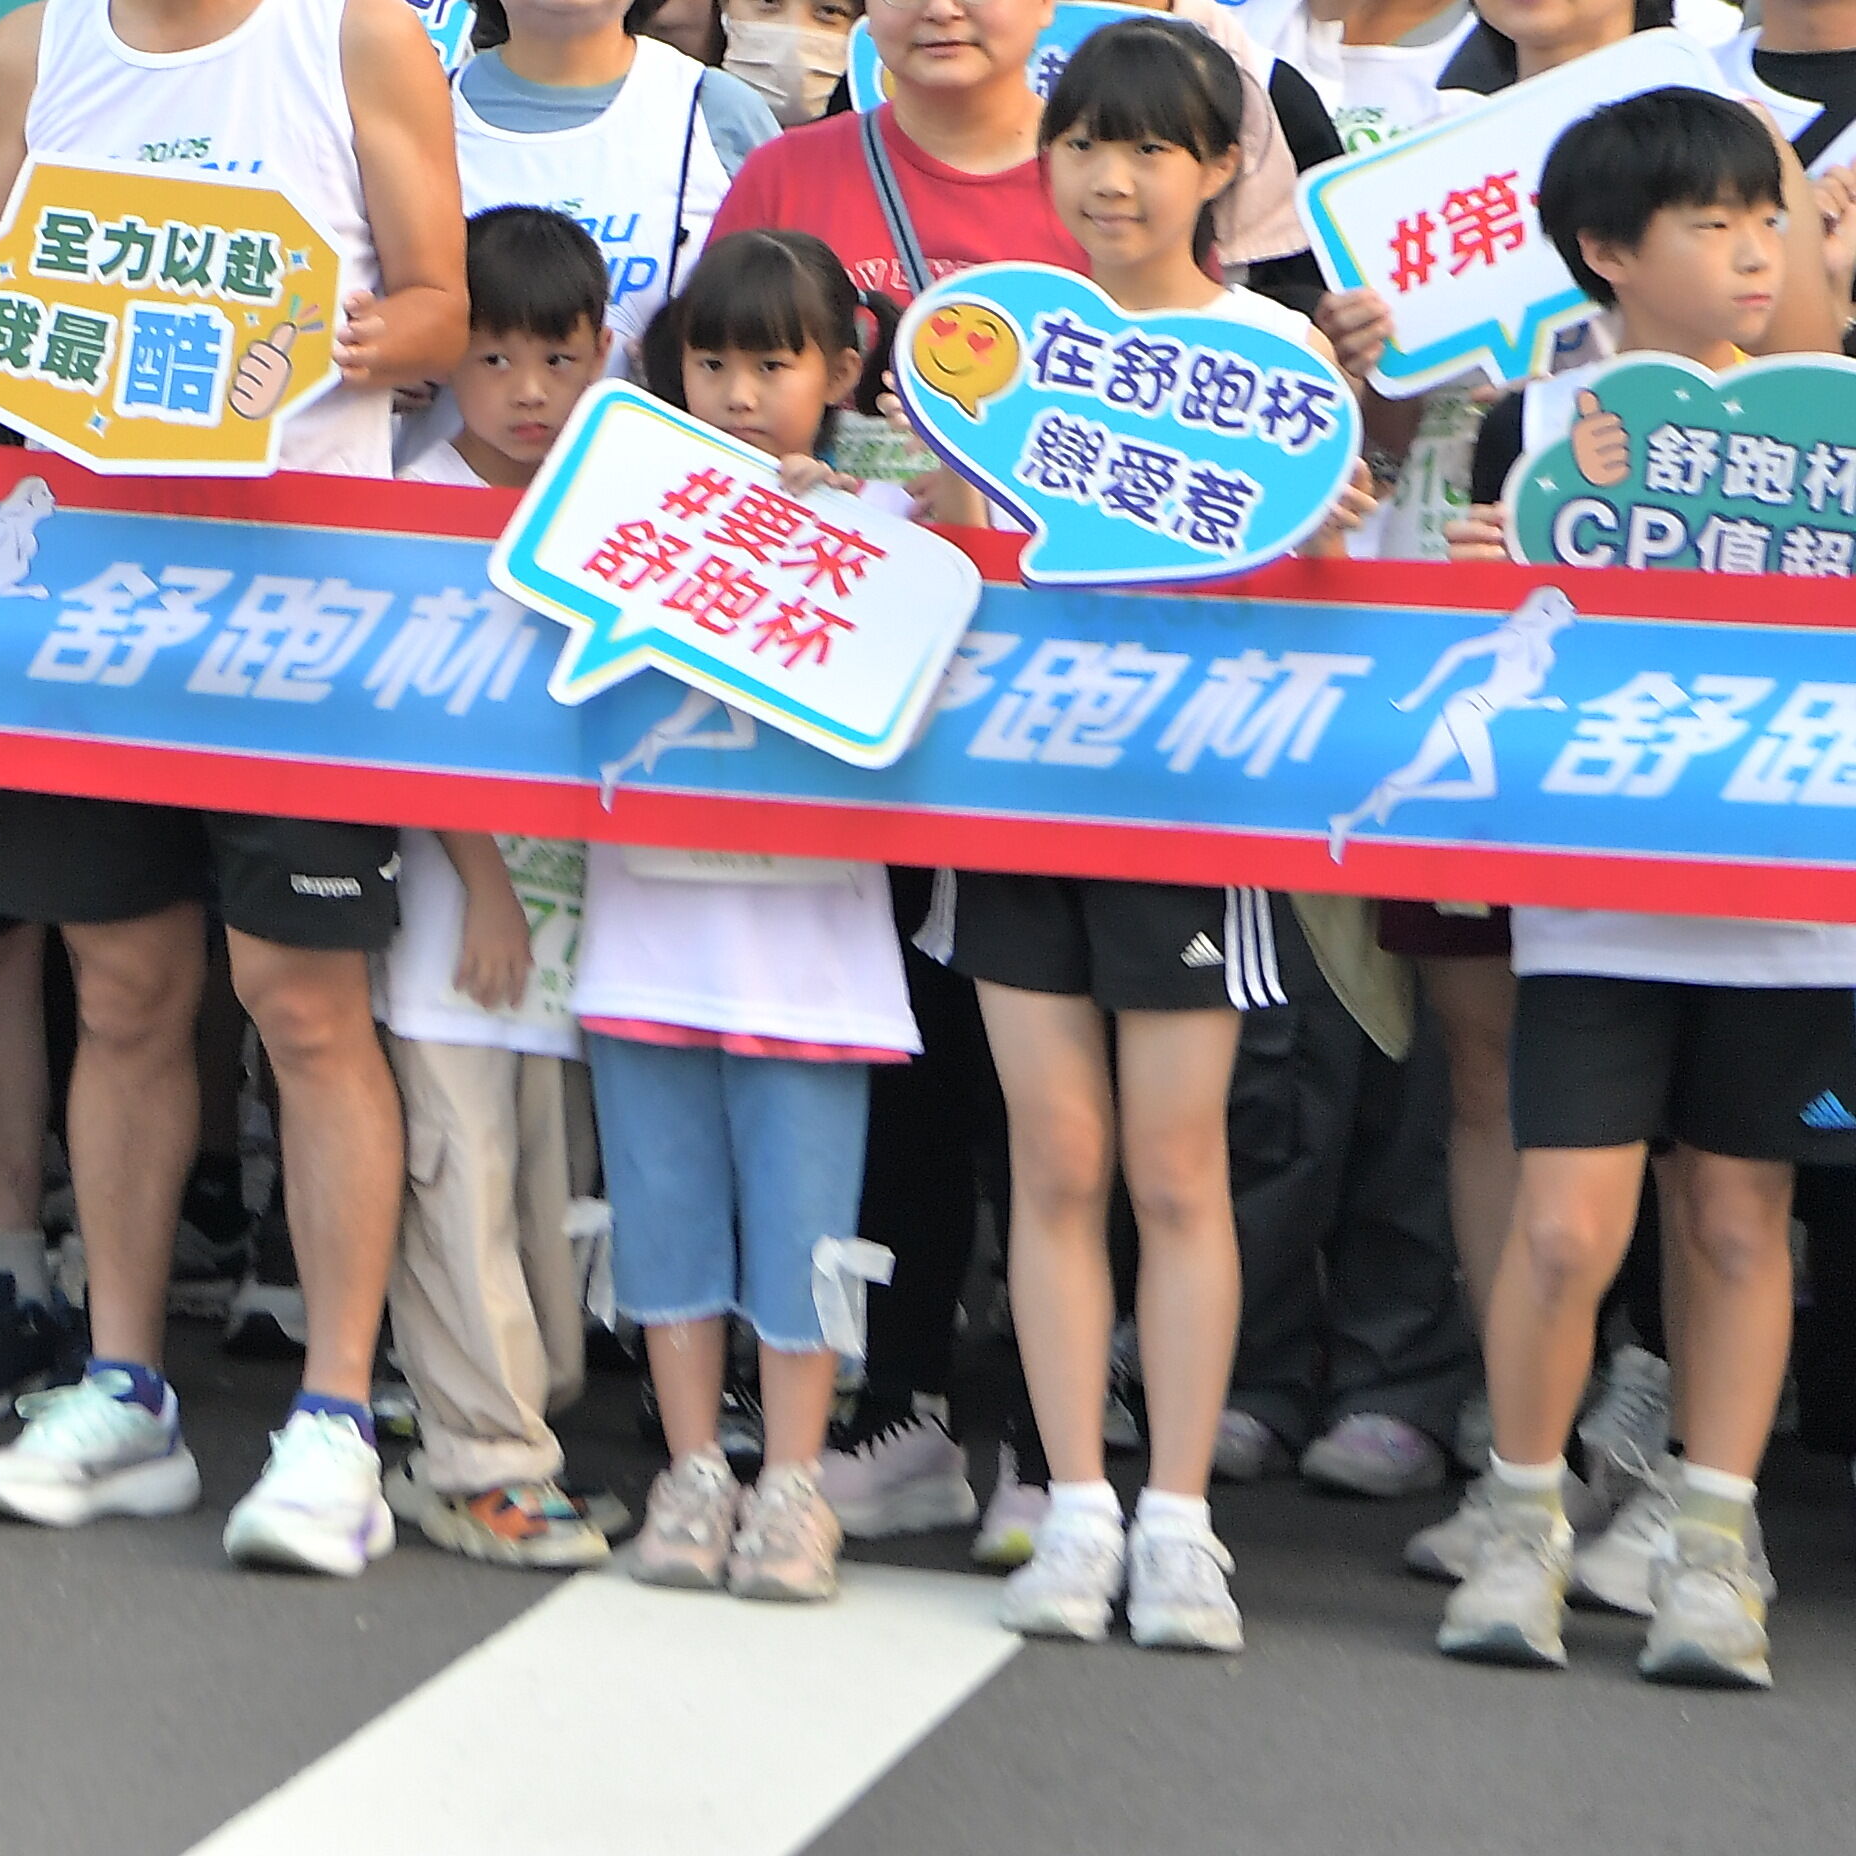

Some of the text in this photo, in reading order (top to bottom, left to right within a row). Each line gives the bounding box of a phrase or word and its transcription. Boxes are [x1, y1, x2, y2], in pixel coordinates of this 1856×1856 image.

[31, 210, 285, 302] 全力以赴
[1390, 169, 1540, 292] #第
[1031, 316, 1337, 447] 在舒跑杯
[582, 516, 859, 672] 舒跑杯
[661, 462, 888, 600] #要來
[26, 560, 541, 717] 舒跑杯
[291, 873, 362, 898] Kappa
